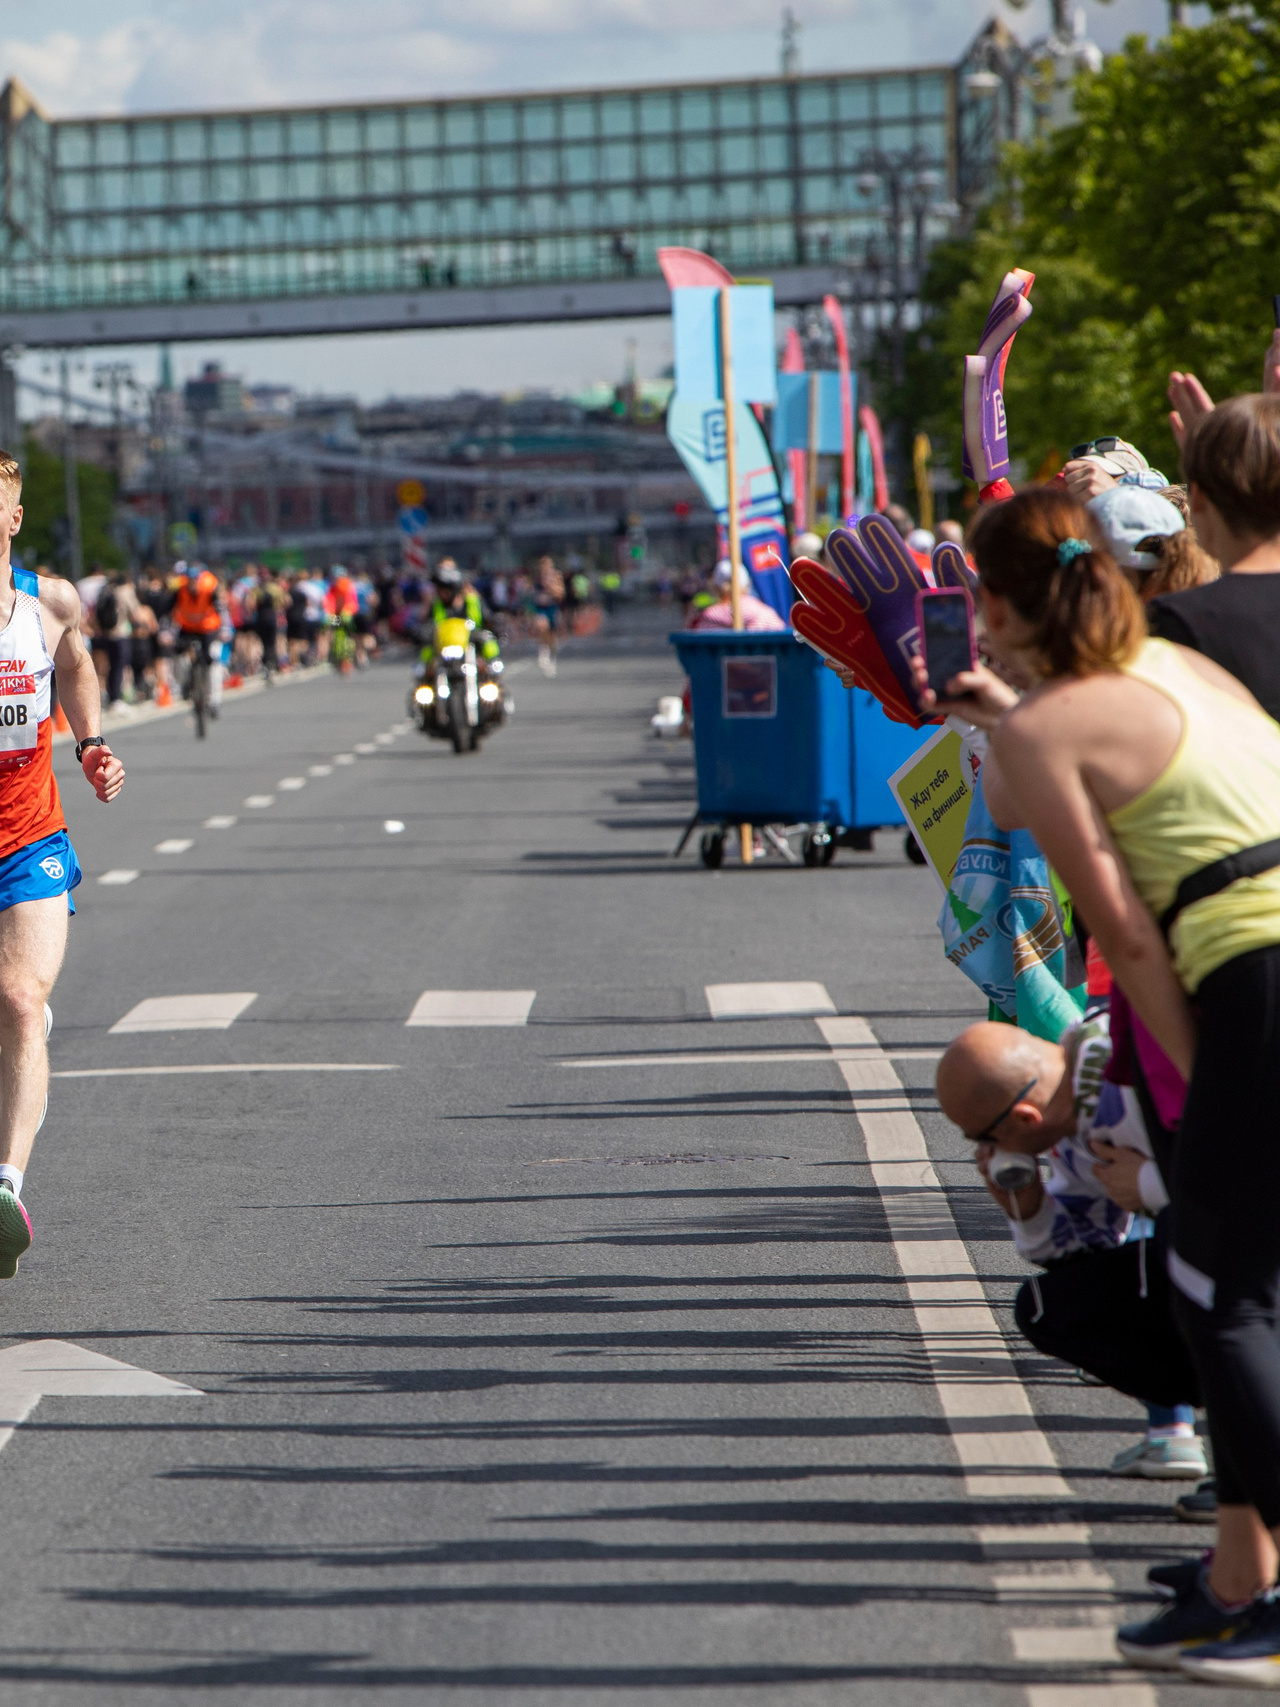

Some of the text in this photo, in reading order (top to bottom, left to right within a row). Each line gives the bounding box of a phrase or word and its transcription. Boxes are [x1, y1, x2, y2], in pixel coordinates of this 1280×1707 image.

[910, 768, 950, 811] Жду тебя
[922, 779, 969, 832] на финише!
